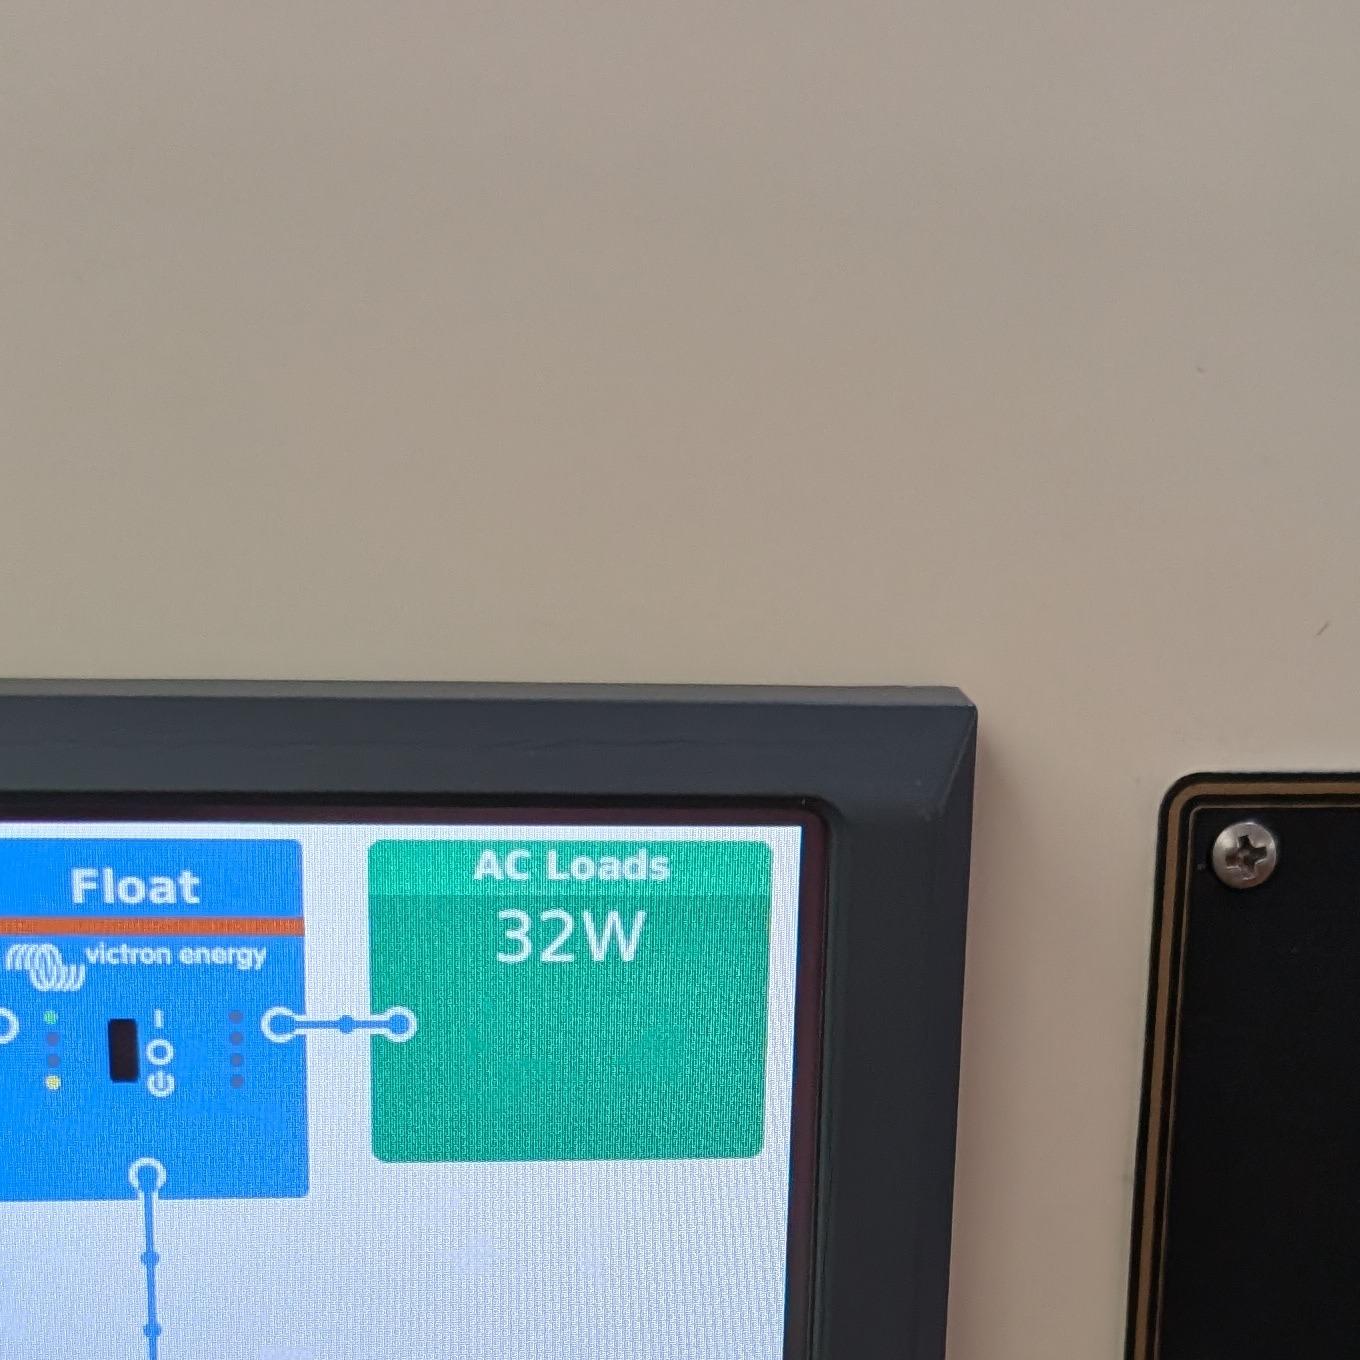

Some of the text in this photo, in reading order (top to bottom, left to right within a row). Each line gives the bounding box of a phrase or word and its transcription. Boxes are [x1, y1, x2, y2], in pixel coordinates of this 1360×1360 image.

[472, 848, 672, 882] AC Loads
[70, 866, 201, 905] Float
[496, 908, 647, 964] 32W
[84, 943, 267, 970] victron energy
